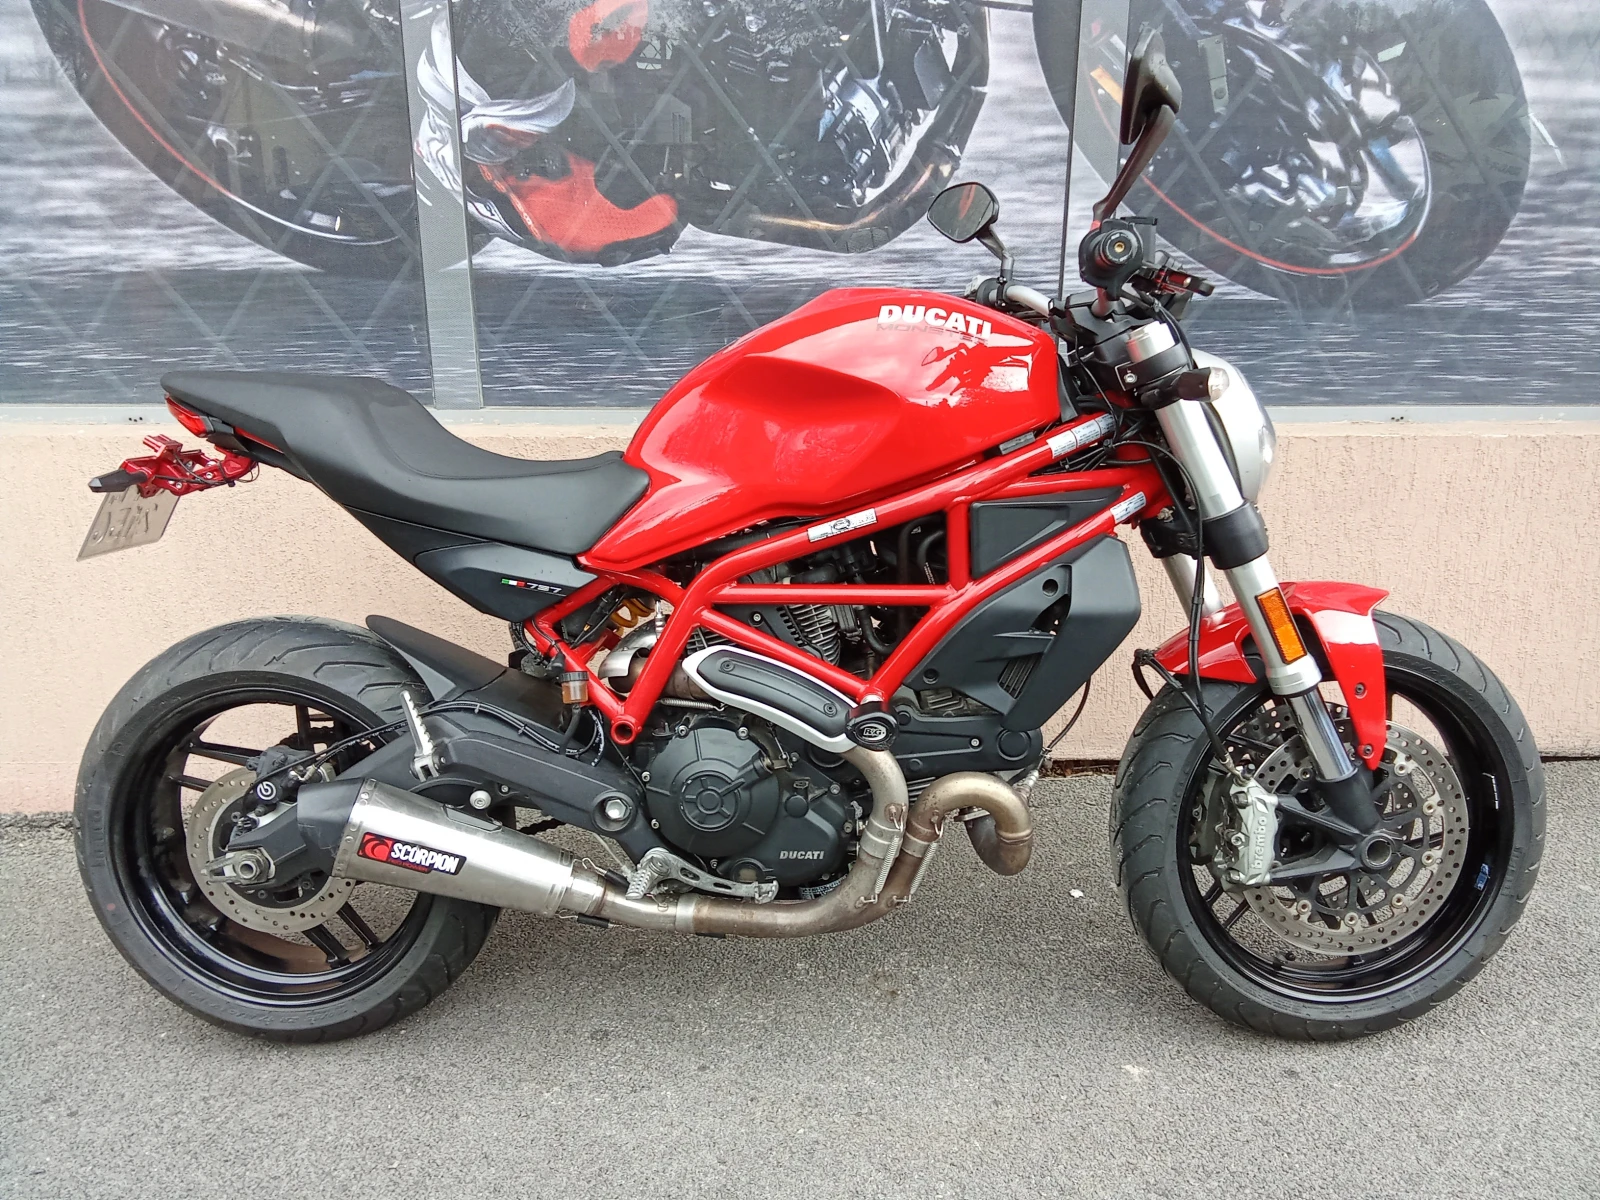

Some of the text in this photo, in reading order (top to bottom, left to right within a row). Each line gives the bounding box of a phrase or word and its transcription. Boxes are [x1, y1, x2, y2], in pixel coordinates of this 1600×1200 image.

[878, 304, 992, 339] DUCATI
[526, 582, 562, 593] 797
[863, 728, 882, 737] R&G
[1251, 816, 1267, 870] brembo
[391, 842, 460, 874] SCORPION
[779, 850, 825, 860] DUCATI
